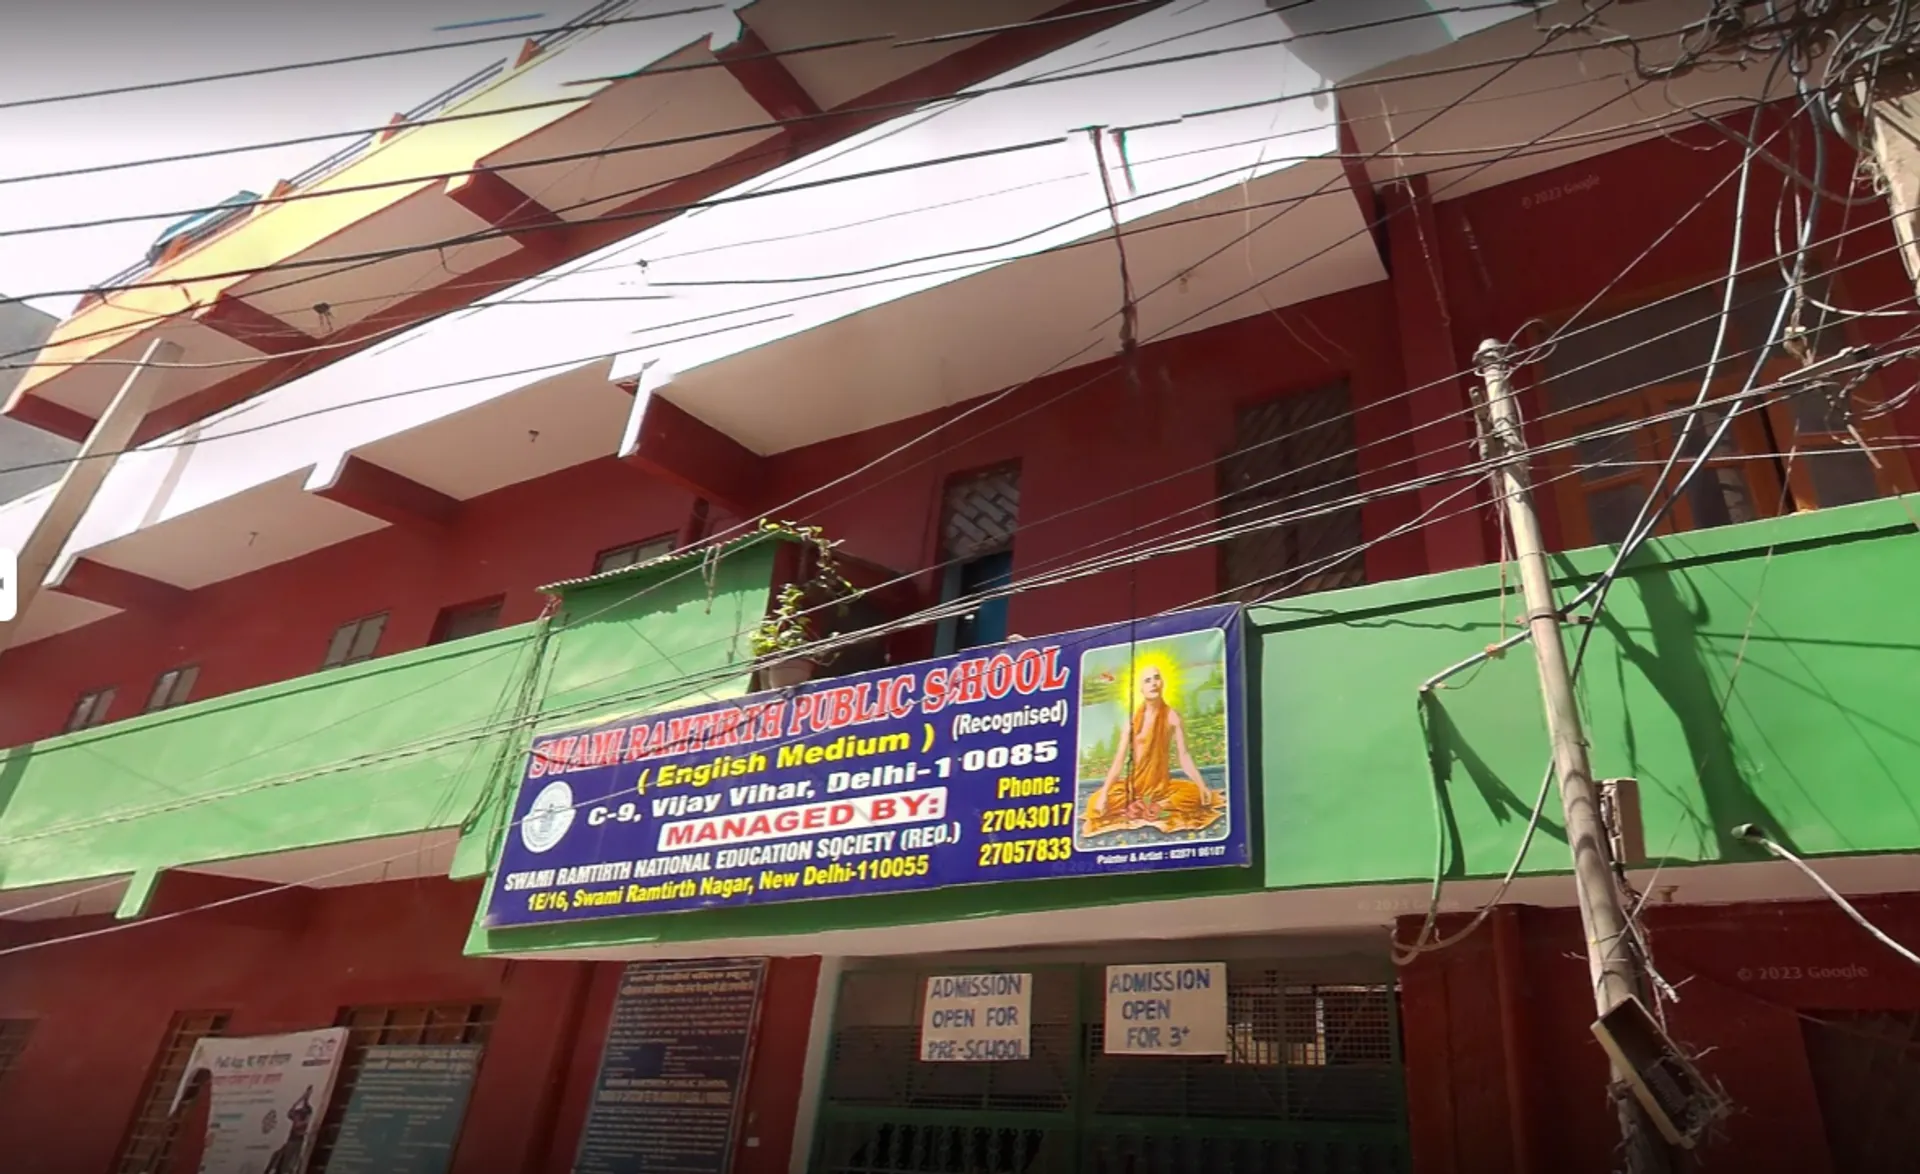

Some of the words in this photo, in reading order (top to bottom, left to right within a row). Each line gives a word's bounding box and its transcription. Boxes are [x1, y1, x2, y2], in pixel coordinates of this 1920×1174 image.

[527, 727, 626, 779] SWAMI
[624, 698, 788, 763] RAMTIRTH
[788, 673, 916, 737] PUBLIC
[952, 699, 1068, 740] (Recognised)
[776, 730, 911, 769] Medium
[587, 802, 642, 826] C-9,
[652, 792, 722, 818] Vijay
[729, 779, 816, 808] Vihar,
[997, 776, 1061, 799] Phone:
[665, 803, 855, 847] MANAGED
[871, 792, 940, 822] BY:
[980, 802, 1074, 834] 27043017
[504, 868, 556, 892] SWAMI
[556, 860, 633, 886] RAMTIRTH
[633, 851, 712, 879] NATIONAL
[715, 839, 814, 870] EDUCATION
[816, 830, 897, 861] SOCIETY
[978, 836, 1072, 867] 27057833
[527, 889, 569, 913] 1E/16,
[572, 885, 625, 908] Swami
[625, 877, 697, 903] Ramtirth
[699, 873, 756, 898] Nagar,
[758, 869, 800, 891] New
[802, 853, 930, 887] Delhi-110055
[930, 974, 1022, 999] ADMISSION
[1109, 967, 1211, 994] ADMISSION
[931, 1007, 976, 1029] OPEN
[985, 1005, 1020, 1027] FOR
[1121, 998, 1172, 1020] OPEN
[927, 1037, 1028, 1060] PRE-SCHOOL
[1126, 1025, 1162, 1048] FOR
[1168, 1024, 1191, 1048] 3+
